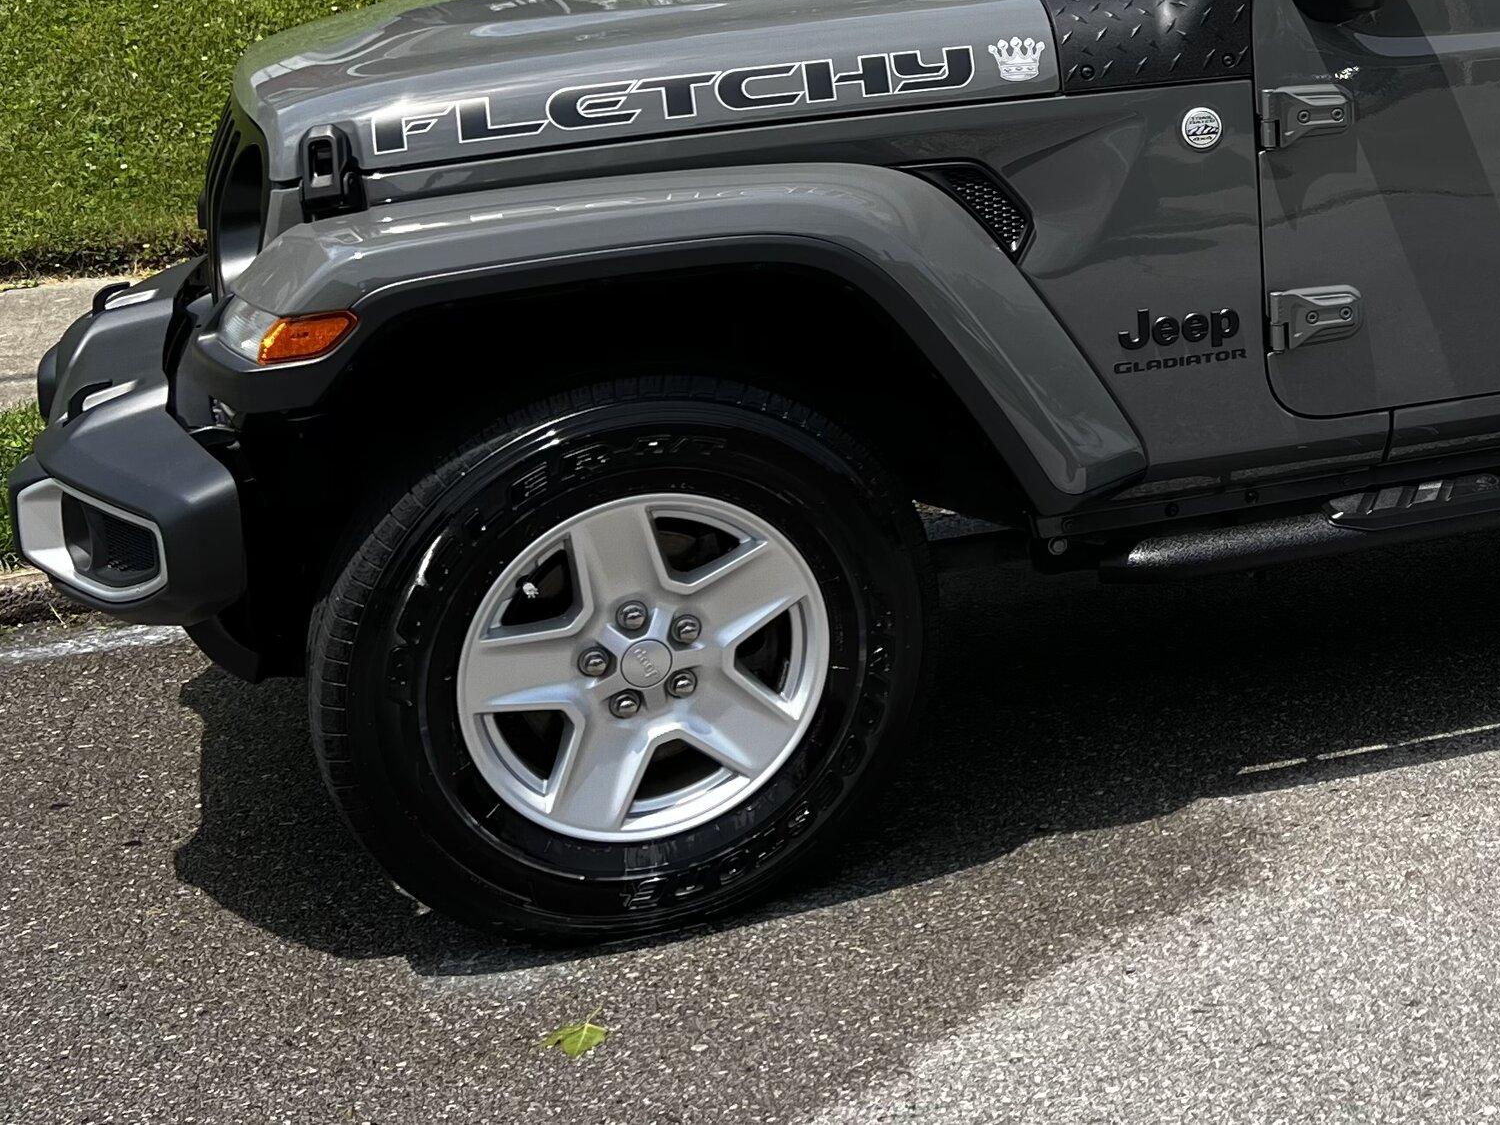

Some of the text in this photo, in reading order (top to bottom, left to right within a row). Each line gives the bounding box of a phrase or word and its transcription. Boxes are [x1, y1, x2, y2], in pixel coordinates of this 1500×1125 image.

[372, 45, 976, 156] FLETCHY
[1118, 307, 1240, 350] Jeep
[1113, 348, 1247, 374] GLADIATOR
